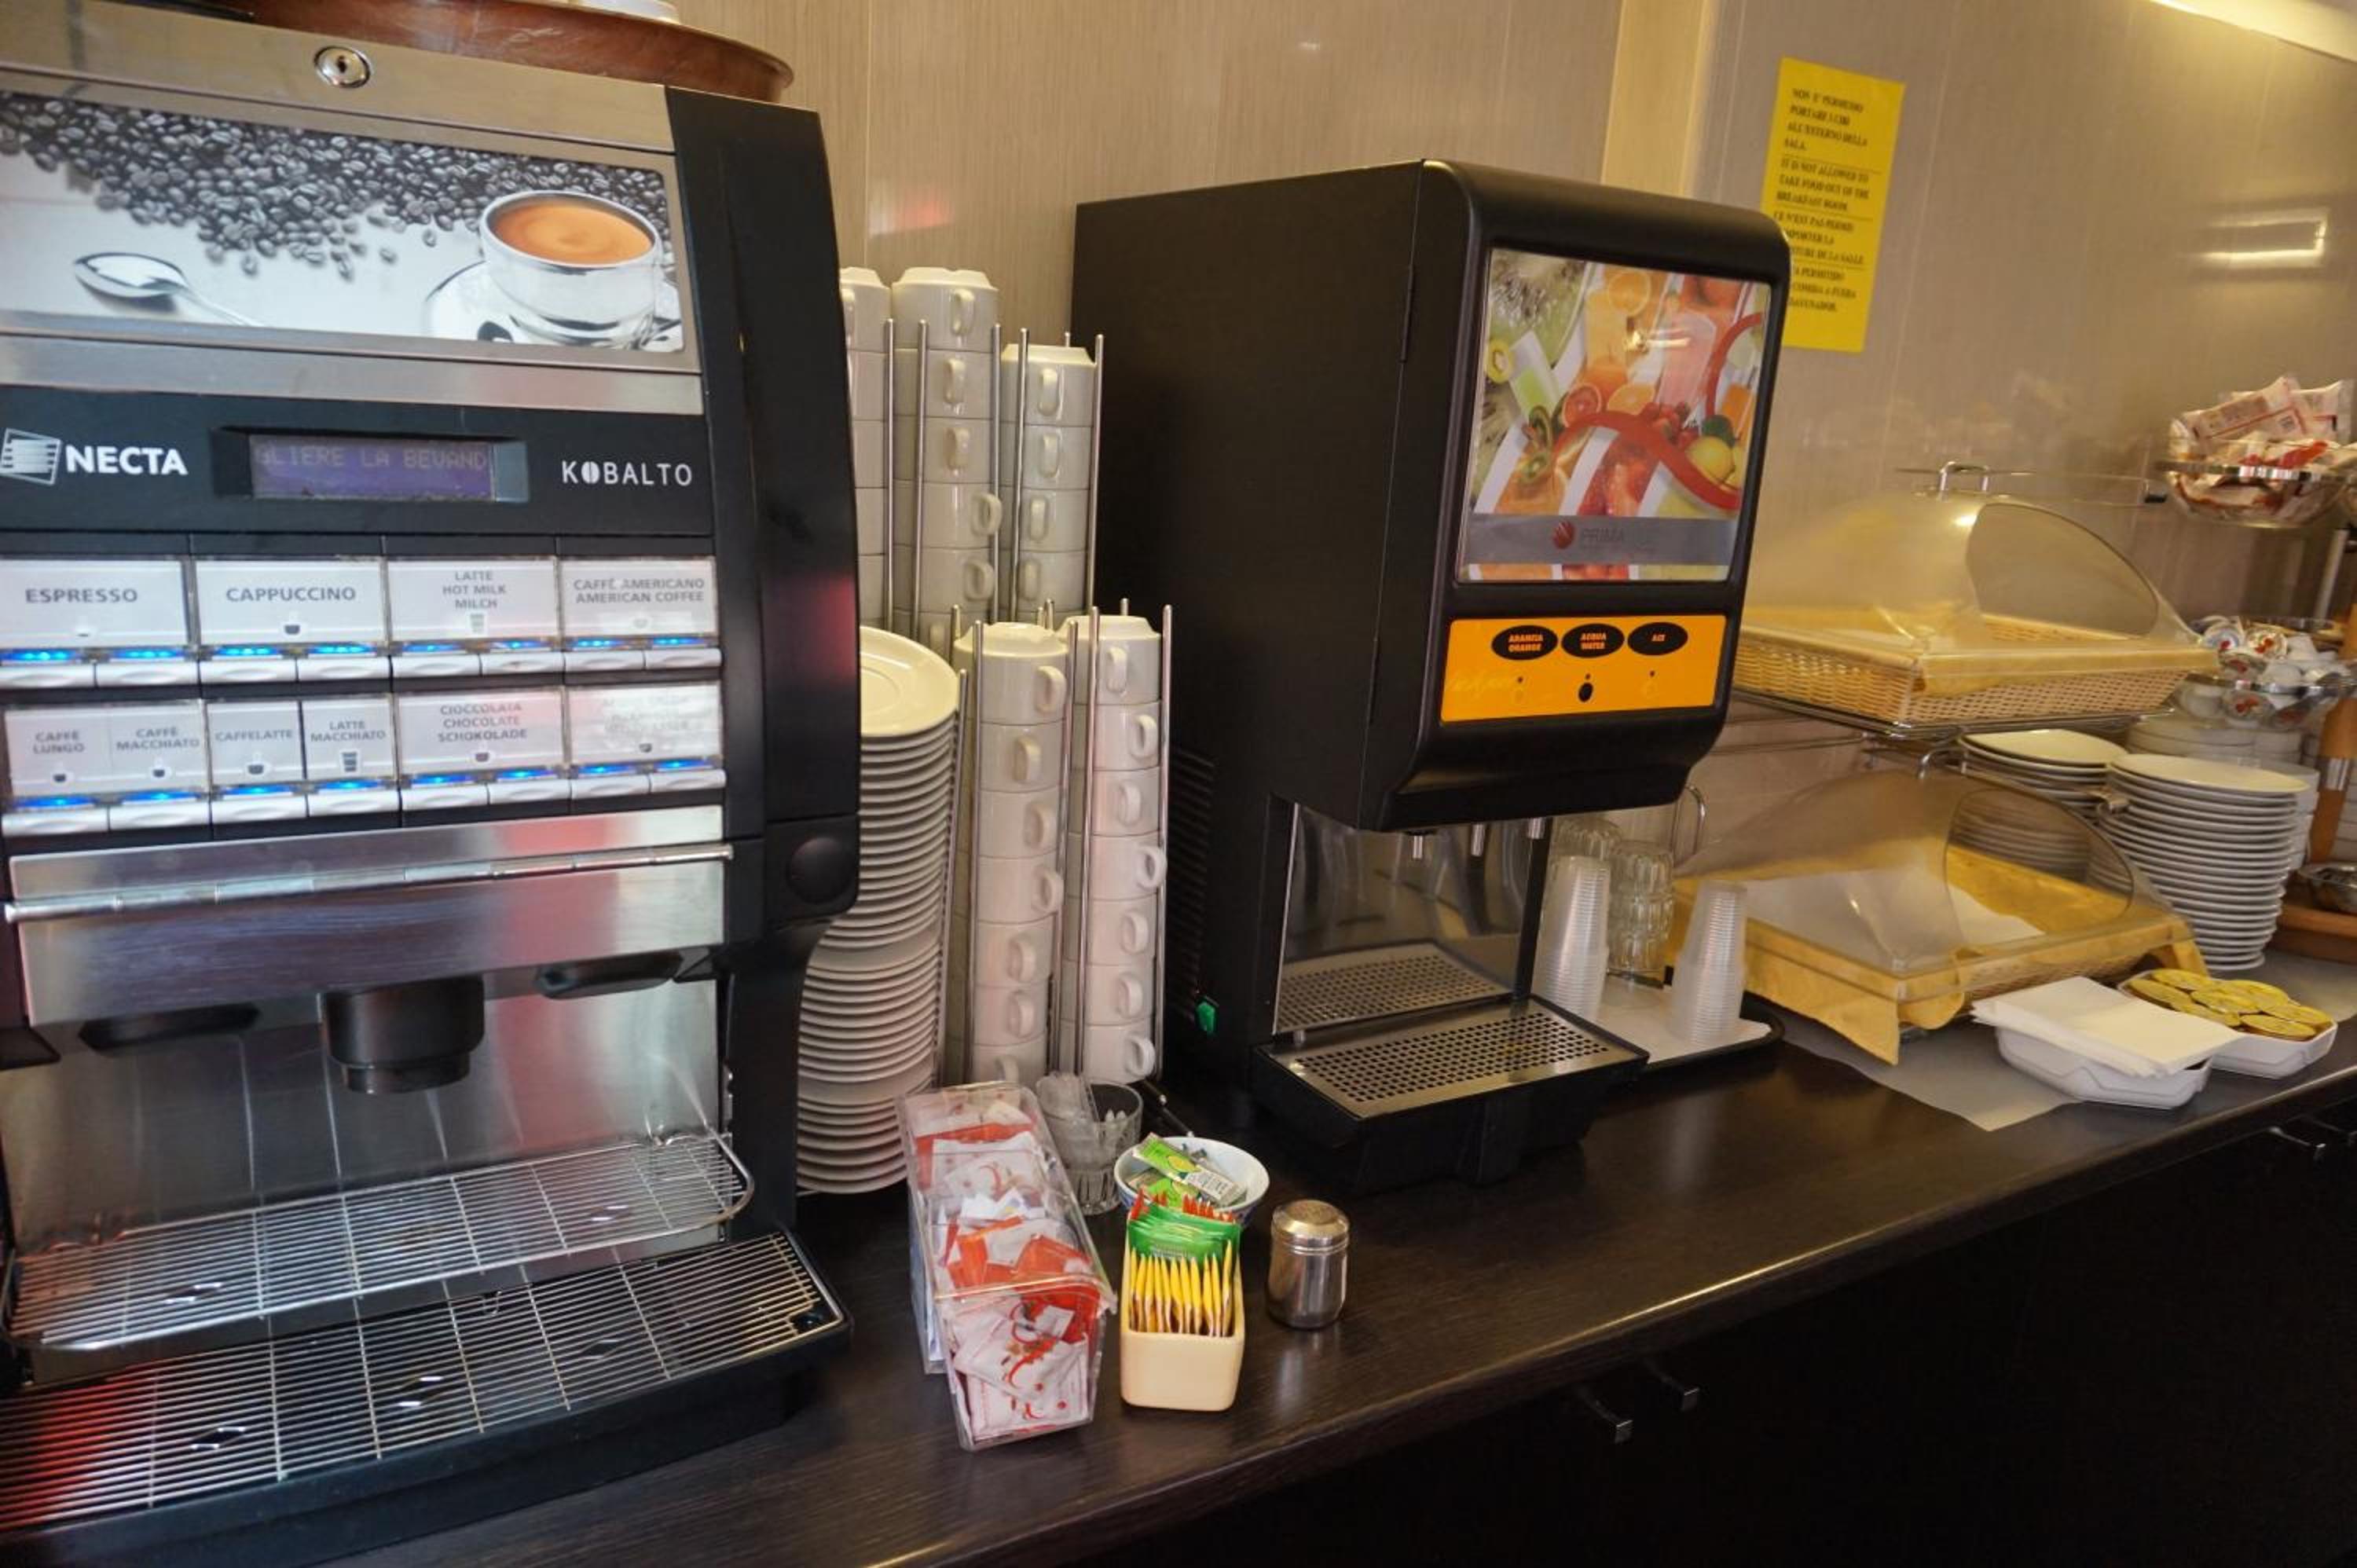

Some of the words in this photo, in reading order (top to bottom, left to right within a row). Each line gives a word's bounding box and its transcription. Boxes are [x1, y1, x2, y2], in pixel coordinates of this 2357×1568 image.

[1801, 163, 1817, 174] NOT
[1817, 165, 1857, 181] ALLOWED
[1779, 174, 1800, 187] TAKE
[1854, 188, 1870, 200] THE
[65, 445, 188, 475] NECTA
[361, 447, 390, 467] LA
[562, 460, 692, 487] KOBALTO
[454, 570, 493, 582] LATTE
[442, 584, 469, 595] HOT
[474, 584, 508, 595] MILK
[620, 577, 706, 589] AMERICANO
[25, 588, 138, 604] ESPRESSO
[226, 587, 356, 603] CAPPUCCINO
[576, 592, 651, 604] AMERICAN
[654, 591, 705, 603] COFFEE
[455, 597, 498, 609] MILCH
[440, 703, 523, 716] CIOCCOLATA
[329, 720, 366, 731] LATTE
[442, 716, 521, 729] CHOCOLATE
[214, 728, 294, 742] CAFFELATTE
[310, 730, 387, 742] MACCHIATO
[438, 728, 528, 743] SCHOKOLADE
[33, 742, 86, 755] LUNGO
[115, 738, 200, 751] MACCHIATO
